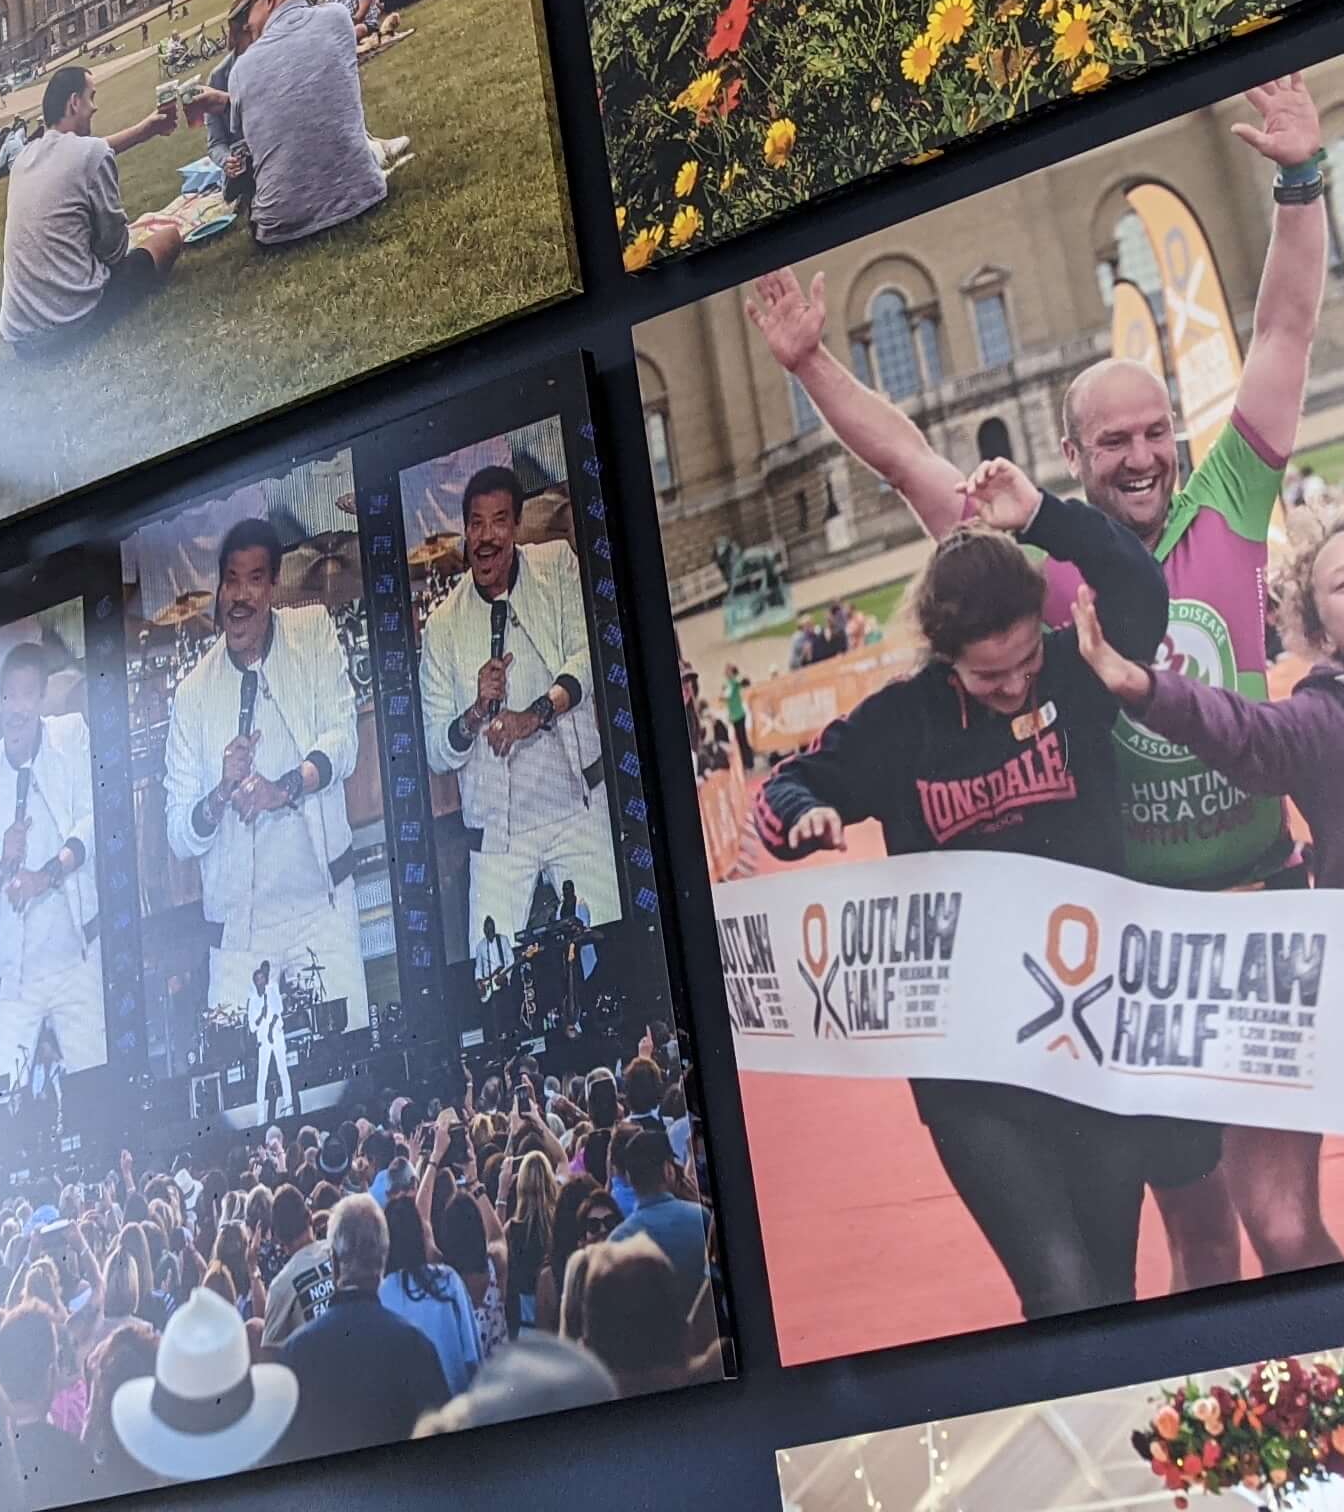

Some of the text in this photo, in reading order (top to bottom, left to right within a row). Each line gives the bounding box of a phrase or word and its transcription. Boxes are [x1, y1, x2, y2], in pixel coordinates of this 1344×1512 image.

[1178, 605, 1227, 647] DISEASE
[915, 731, 1077, 845] LONSDALE
[1175, 799, 1196, 822] A
[717, 913, 776, 975] UTLAW
[840, 892, 962, 967] OUTLAW
[1118, 923, 1327, 1007] OUTLAW
[844, 968, 896, 1032] HALF
[1111, 996, 1219, 1068] HALF
